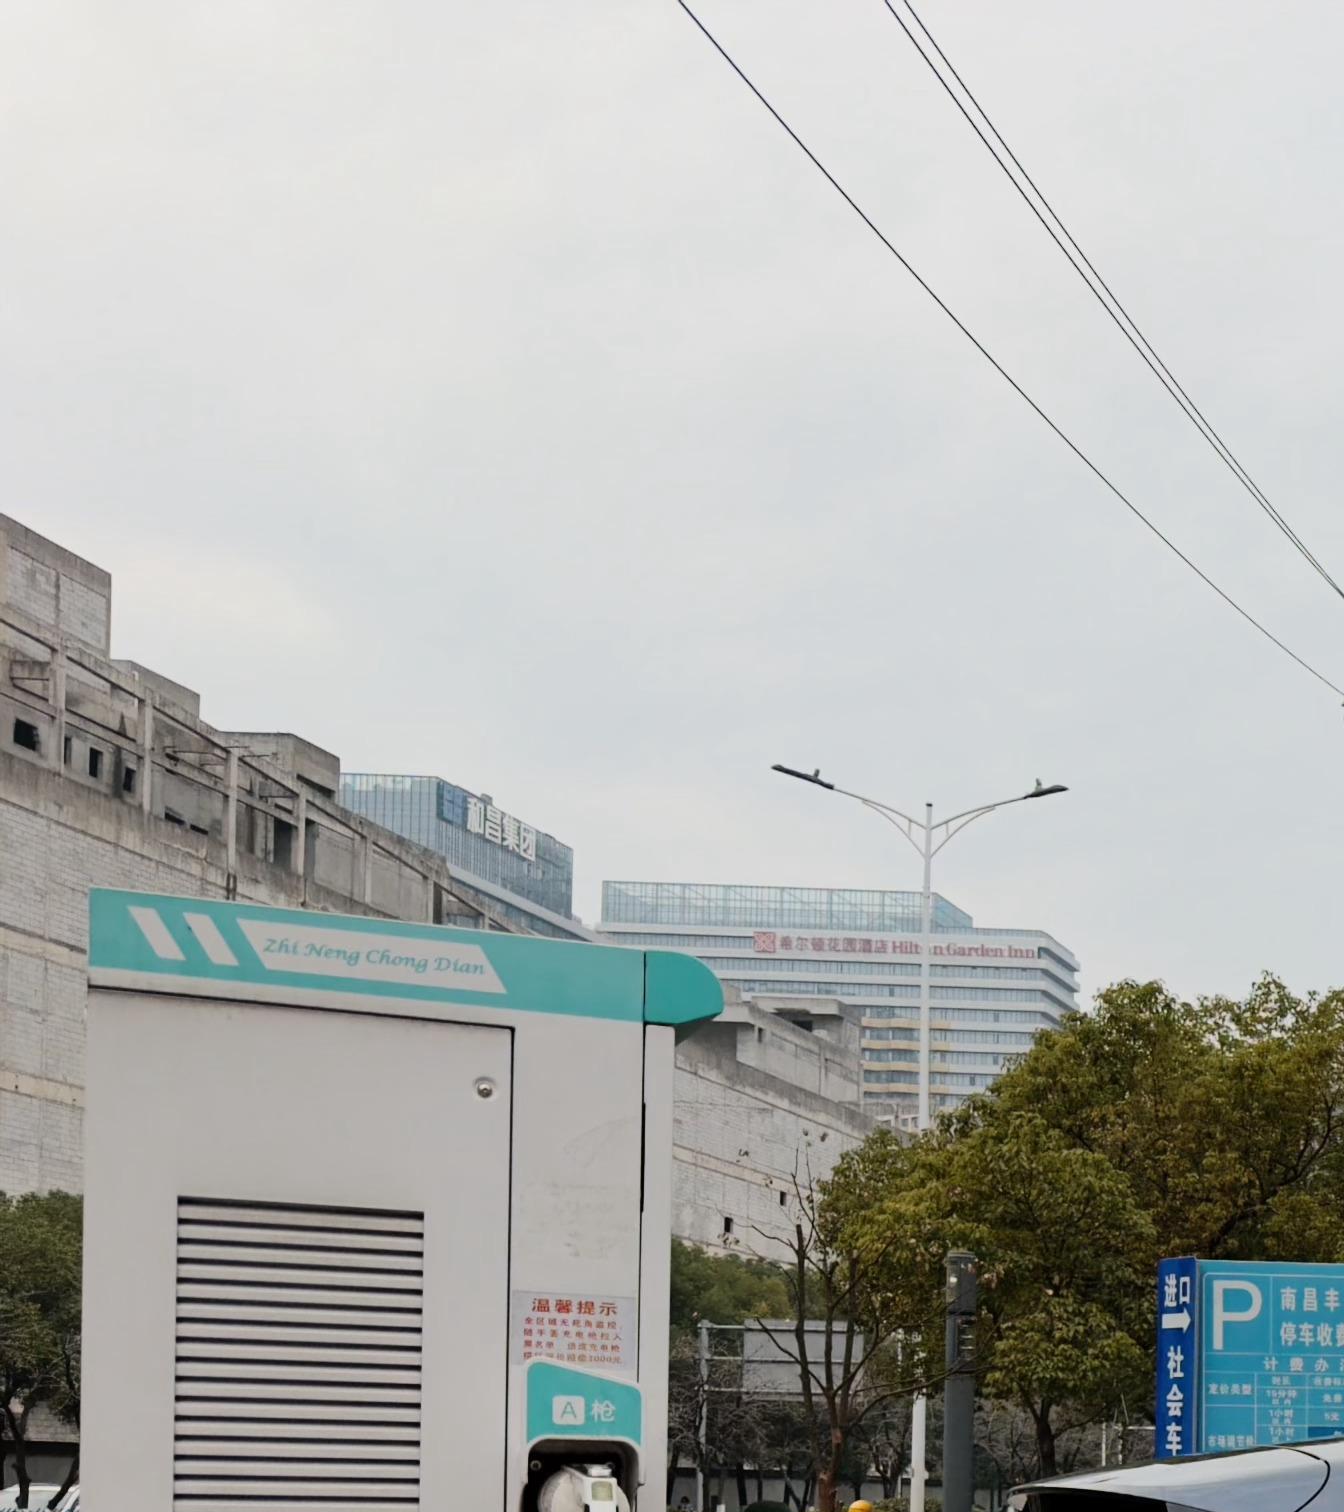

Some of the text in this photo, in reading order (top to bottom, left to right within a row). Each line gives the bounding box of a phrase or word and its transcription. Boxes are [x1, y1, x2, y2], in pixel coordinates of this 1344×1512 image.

[467, 797, 536, 861] 和昌集团
[780, 935, 888, 955] 希尔顿花园酒店
[891, 939, 1036, 960] Hiltn Garden Inn
[263, 938, 485, 975] Zhi Neng Chong Dian
[1163, 1273, 1191, 1308] 进口
[532, 1298, 618, 1316] 温馨提示
[1212, 1280, 1262, 1350] P
[1208, 1383, 1252, 1396] 定价类型
[560, 1400, 616, 1422] A 枪
